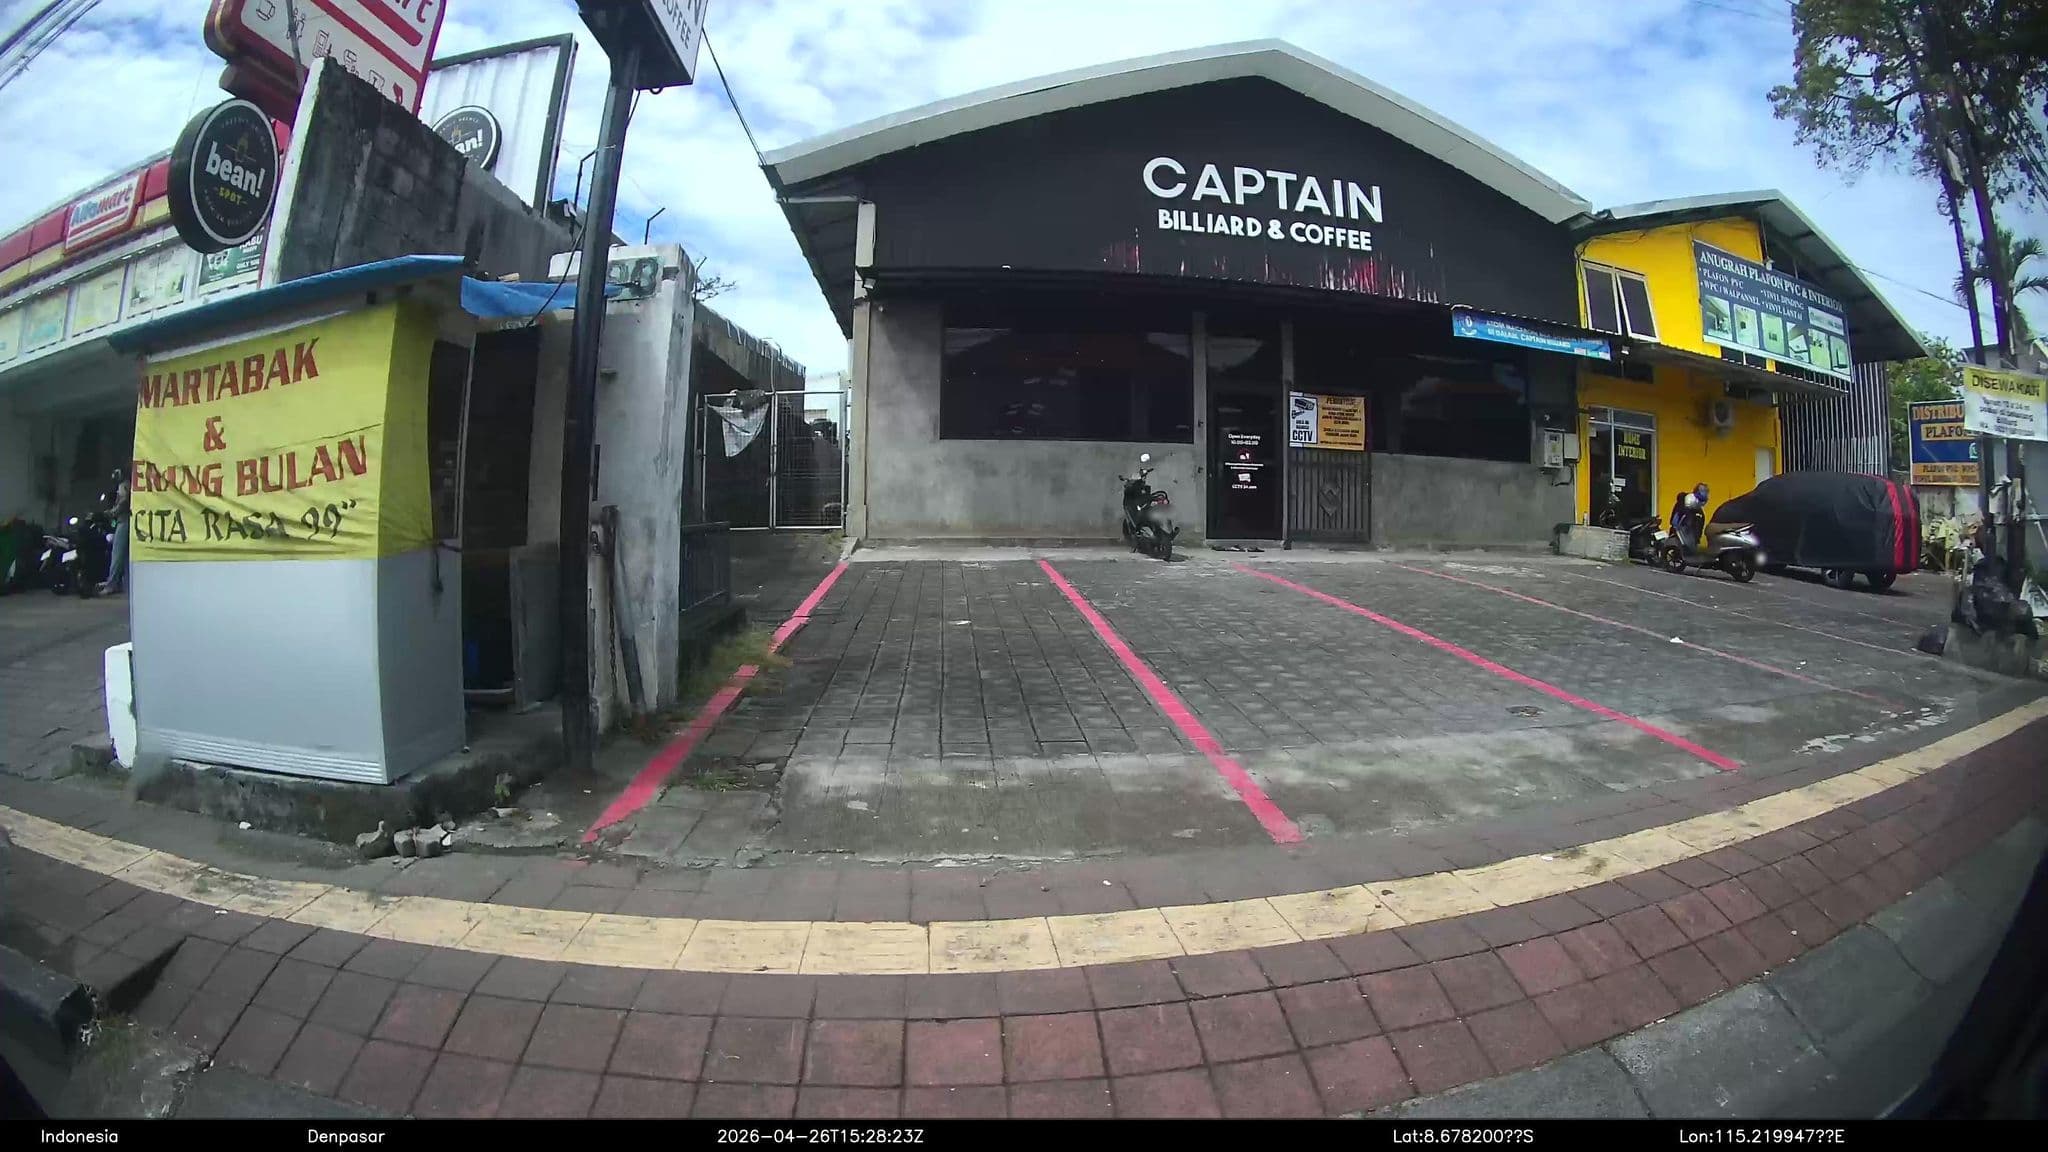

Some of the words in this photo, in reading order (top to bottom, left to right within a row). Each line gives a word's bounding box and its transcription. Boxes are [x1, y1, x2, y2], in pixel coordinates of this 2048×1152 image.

[663, 0, 692, 50] OFFEE
[454, 128, 483, 154] an!
[205, 140, 266, 198] bean!
[1142, 156, 1384, 224] CAPTAIN
[1157, 208, 1263, 238] BILLIARD
[1267, 218, 1286, 241] &
[1289, 221, 1373, 252] COFFEE
[1700, 250, 1748, 277] ANUGRAH
[1749, 267, 1784, 290] PLAFON
[1784, 280, 1801, 297] PVC
[1703, 267, 1730, 285] PLAFON
[138, 337, 321, 409] MARTABAK
[1972, 374, 2041, 397] DISEWAKAN
[203, 415, 227, 453] &
[1292, 430, 1313, 442] CCTV
[1925, 424, 1967, 438] PLAFO
[236, 434, 368, 497] BULAN
[200, 507, 291, 541] RASA
